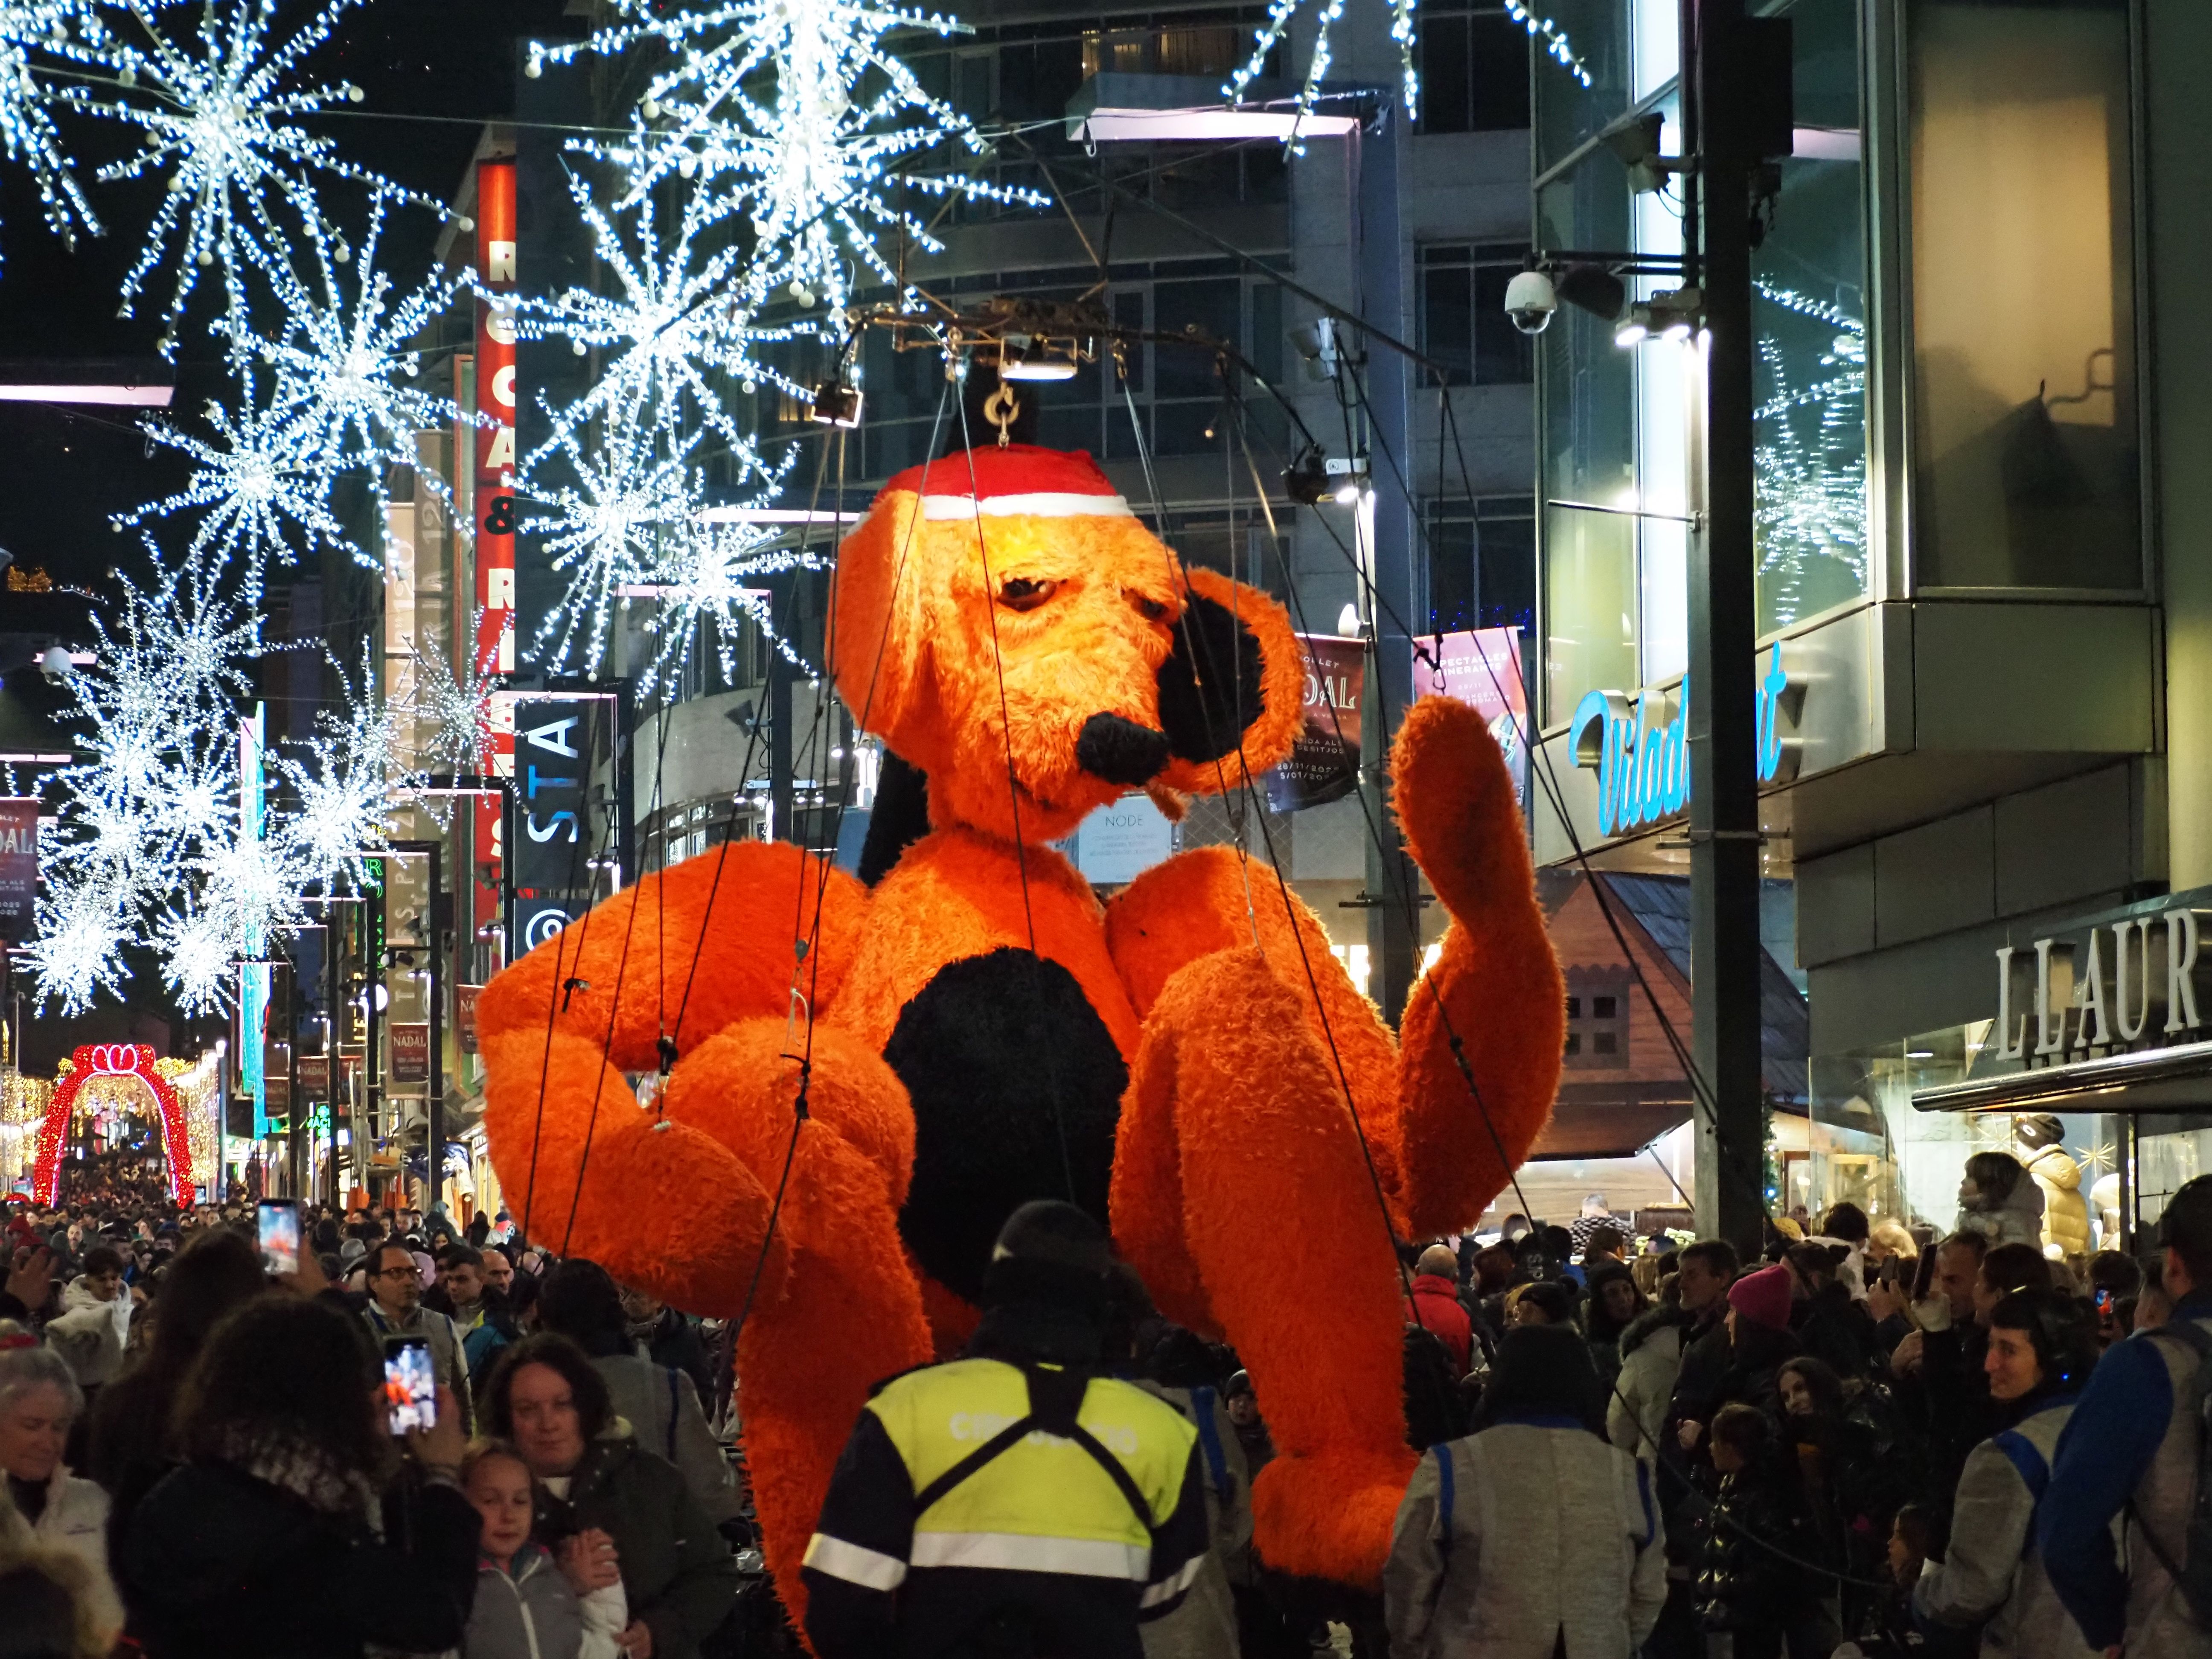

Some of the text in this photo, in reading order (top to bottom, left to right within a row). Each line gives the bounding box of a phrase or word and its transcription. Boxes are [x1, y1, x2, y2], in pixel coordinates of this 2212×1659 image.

[484, 496, 515, 536] &
[1106, 814, 1144, 827] NODE
[393, 1036, 426, 1047] NADAL
